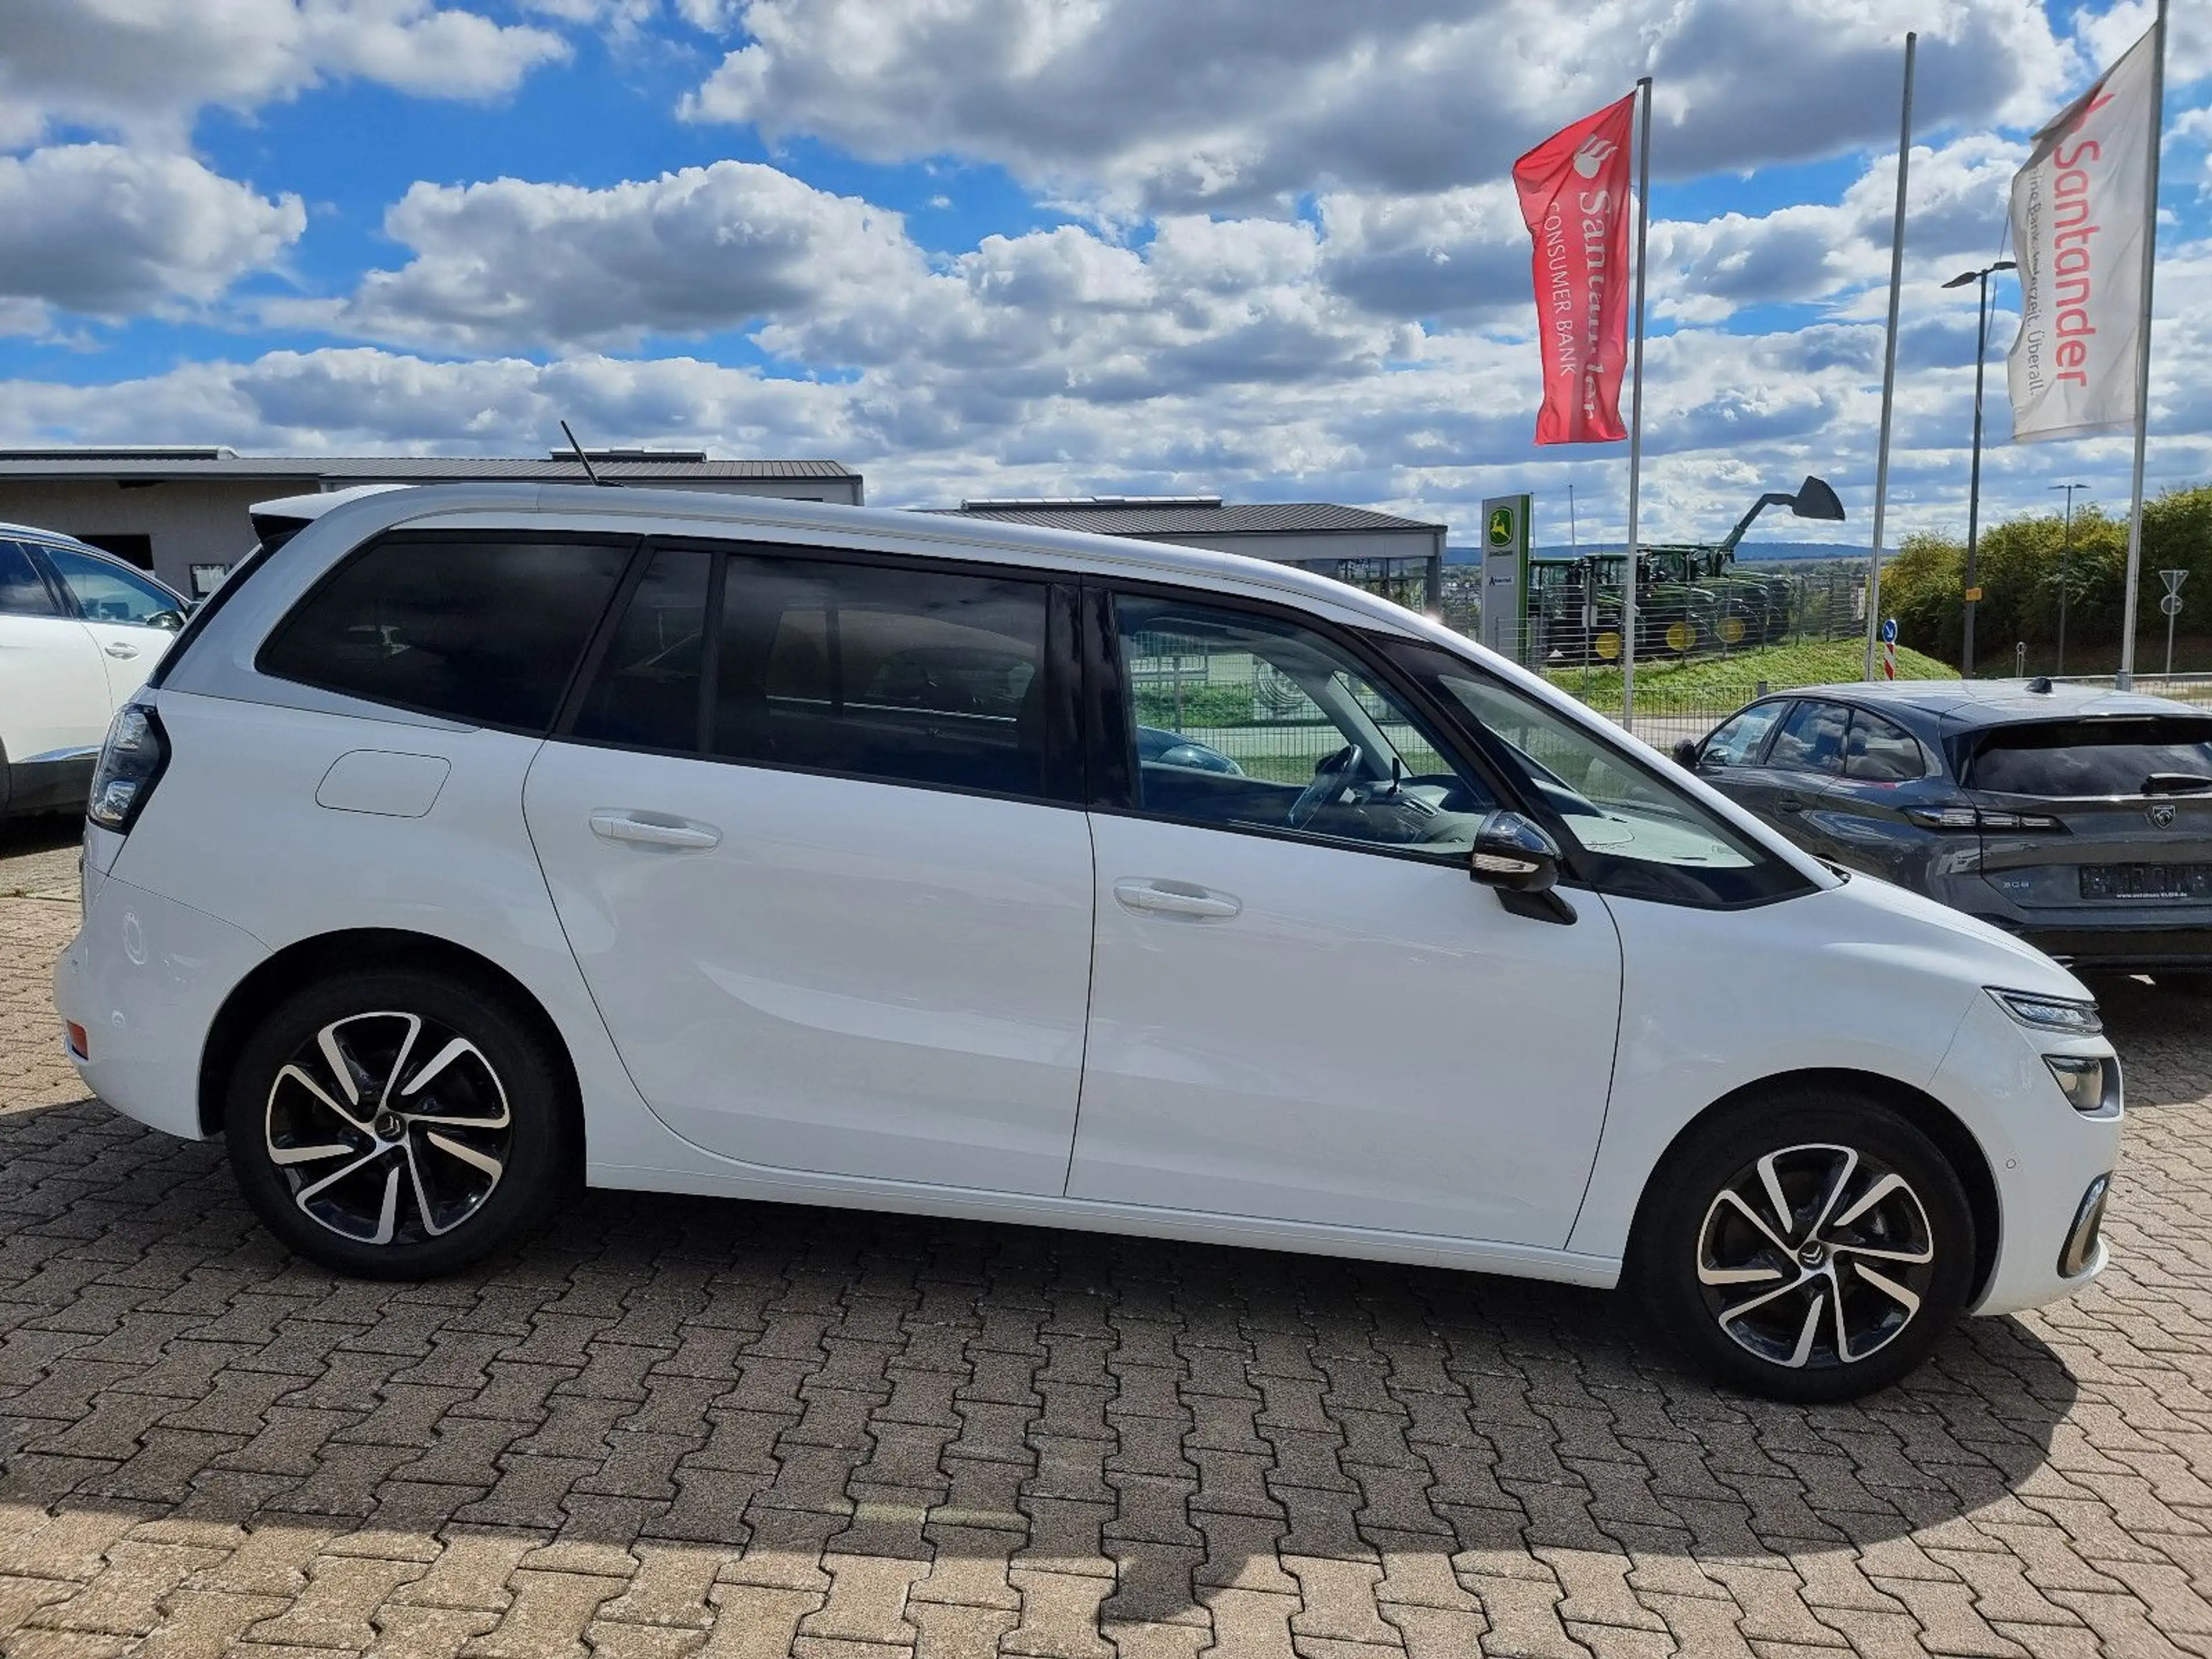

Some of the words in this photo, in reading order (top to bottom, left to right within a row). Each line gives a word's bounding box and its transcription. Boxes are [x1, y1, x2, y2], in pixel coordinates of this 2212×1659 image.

[1544, 202, 1571, 315] CONSUMER
[2054, 140, 2101, 388] Santander
[1555, 320, 1577, 376] BANK
[2028, 329, 2046, 396] Überall.
